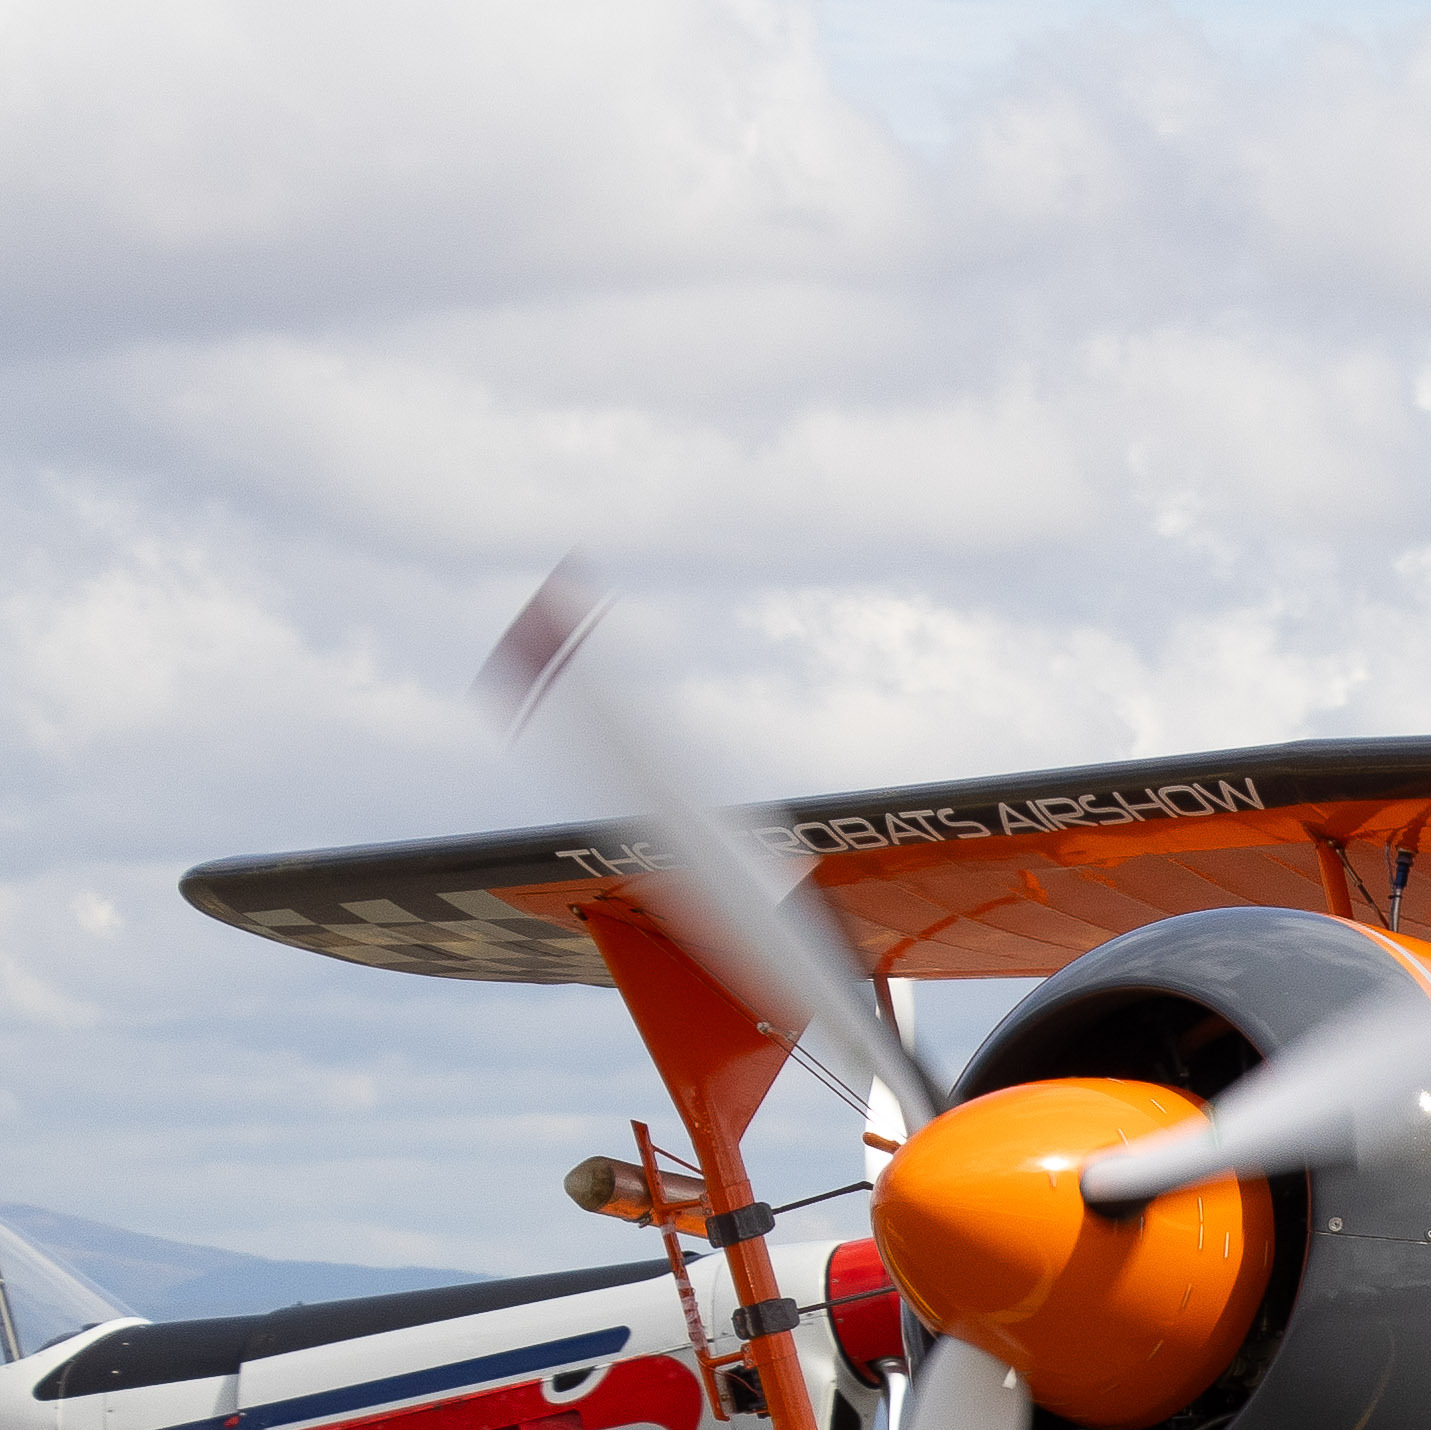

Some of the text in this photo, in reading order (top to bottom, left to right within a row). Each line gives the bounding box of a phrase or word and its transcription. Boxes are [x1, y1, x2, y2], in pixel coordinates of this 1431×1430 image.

[555, 777, 1265, 878] THE ROBATS AIRSHOW
